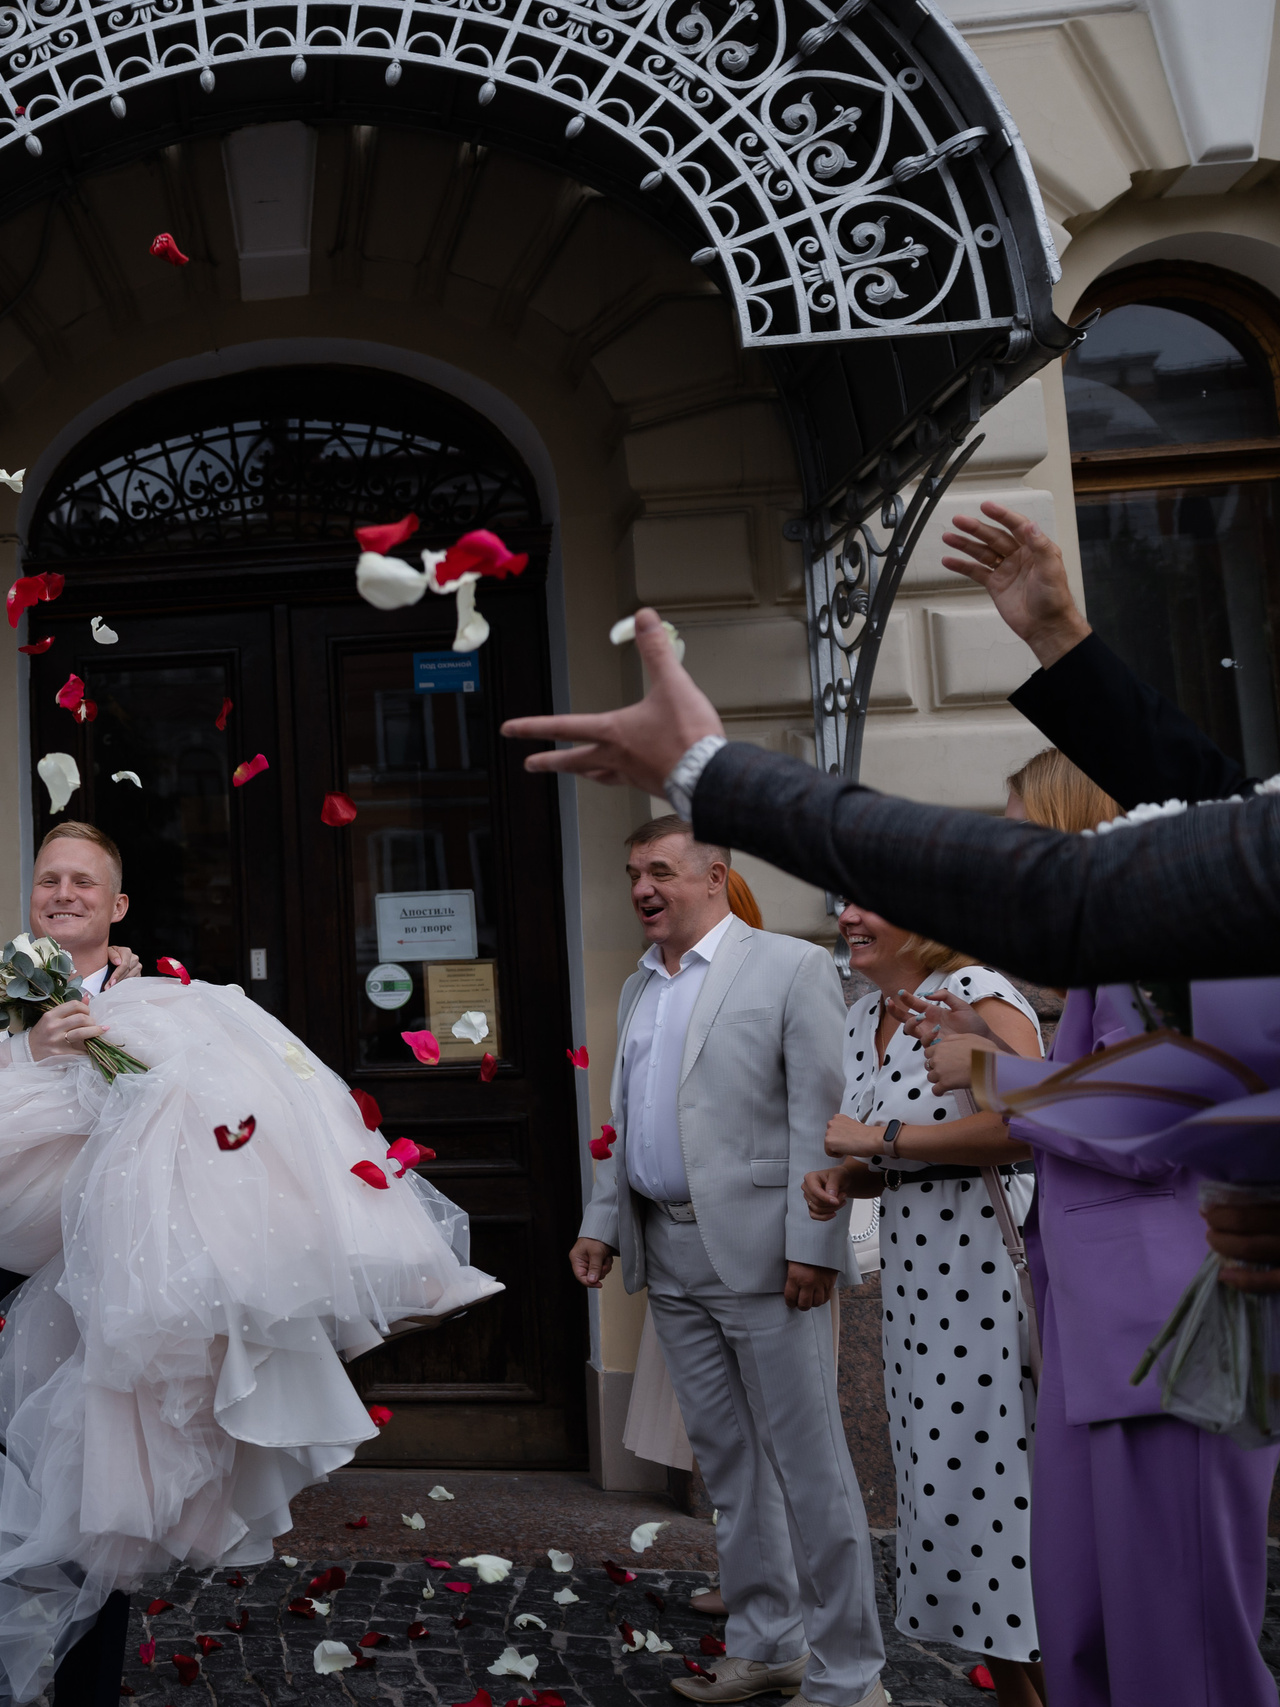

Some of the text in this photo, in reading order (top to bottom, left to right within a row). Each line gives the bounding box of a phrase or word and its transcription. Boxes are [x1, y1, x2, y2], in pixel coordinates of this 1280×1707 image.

[400, 907, 455, 918] Апостиль
[404, 924, 453, 935] во дворе
